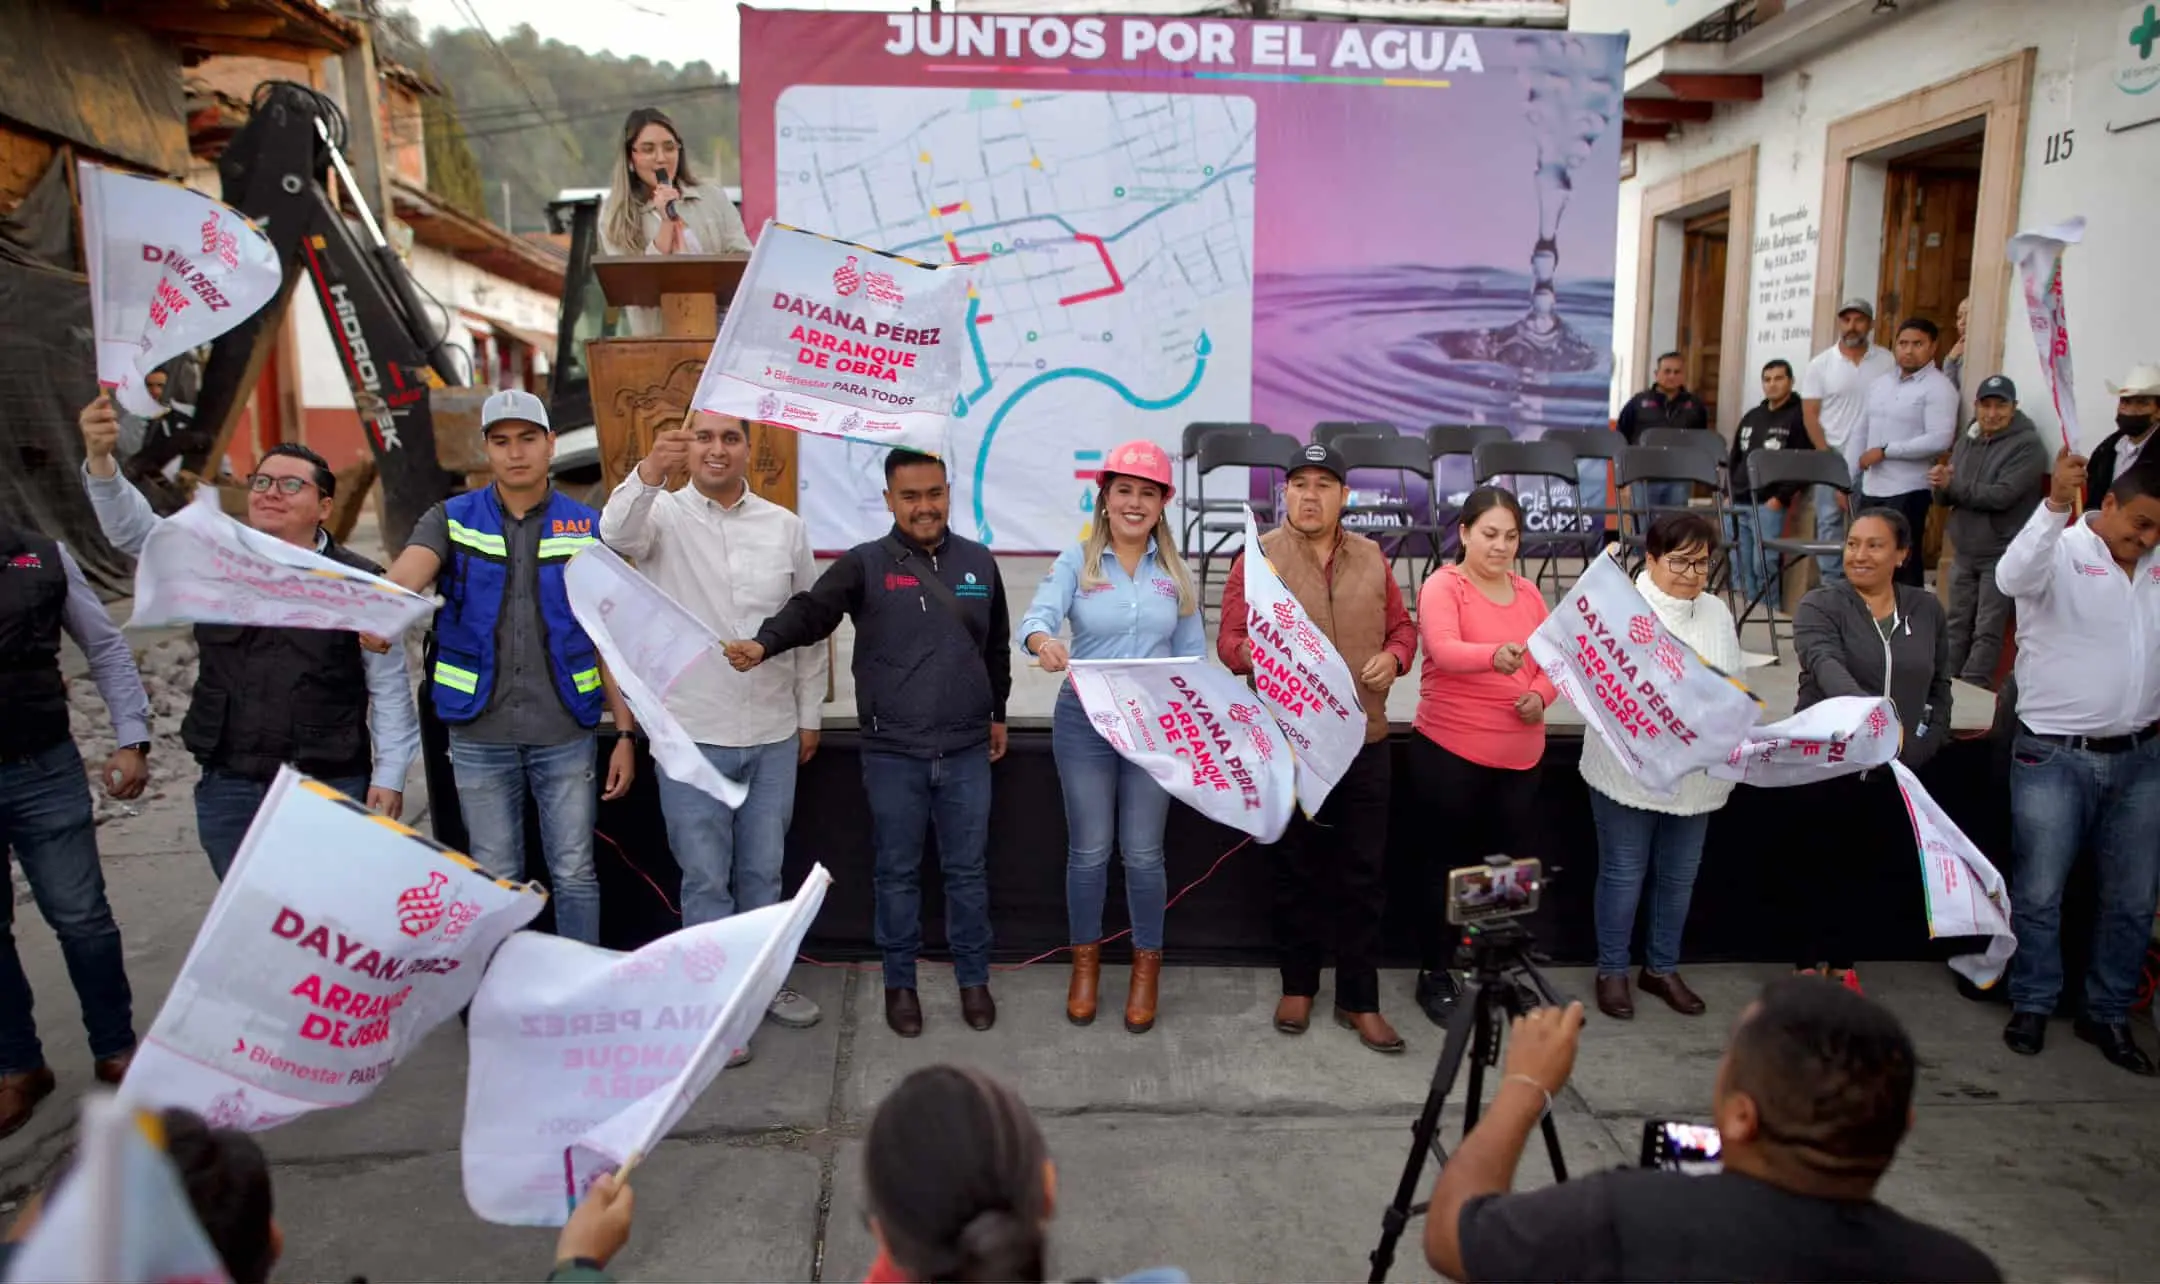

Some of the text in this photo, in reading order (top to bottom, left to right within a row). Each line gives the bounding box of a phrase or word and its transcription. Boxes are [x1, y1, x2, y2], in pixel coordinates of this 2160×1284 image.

[885, 15, 1485, 73] JUNTOS POR EL AGUA
[2044, 129, 2075, 165] 115
[772, 292, 941, 346] DAYANA PÉREZ
[789, 325, 917, 368] ARRANQUE
[797, 347, 898, 383] DE OBRA
[774, 369, 916, 406] Bienestar PARA TODOS
[552, 518, 592, 534] BAU
[1245, 603, 1293, 662] YANA
[1576, 634, 1662, 739] ARRANQUE
[1577, 595, 1699, 746] DAYANA PÉREZ
[1256, 674, 1305, 718] OBRA
[1577, 652, 1596, 680] DE
[1595, 683, 1640, 739] OBRA
[1158, 713, 1182, 743] DE
[1168, 701, 1232, 791] ARRANQUE
[1170, 676, 1261, 811] DAYANA PÉREZ
[271, 906, 406, 982] DAYAN
[299, 1012, 349, 1048] DE
[249, 1045, 345, 1085] Bienestar
